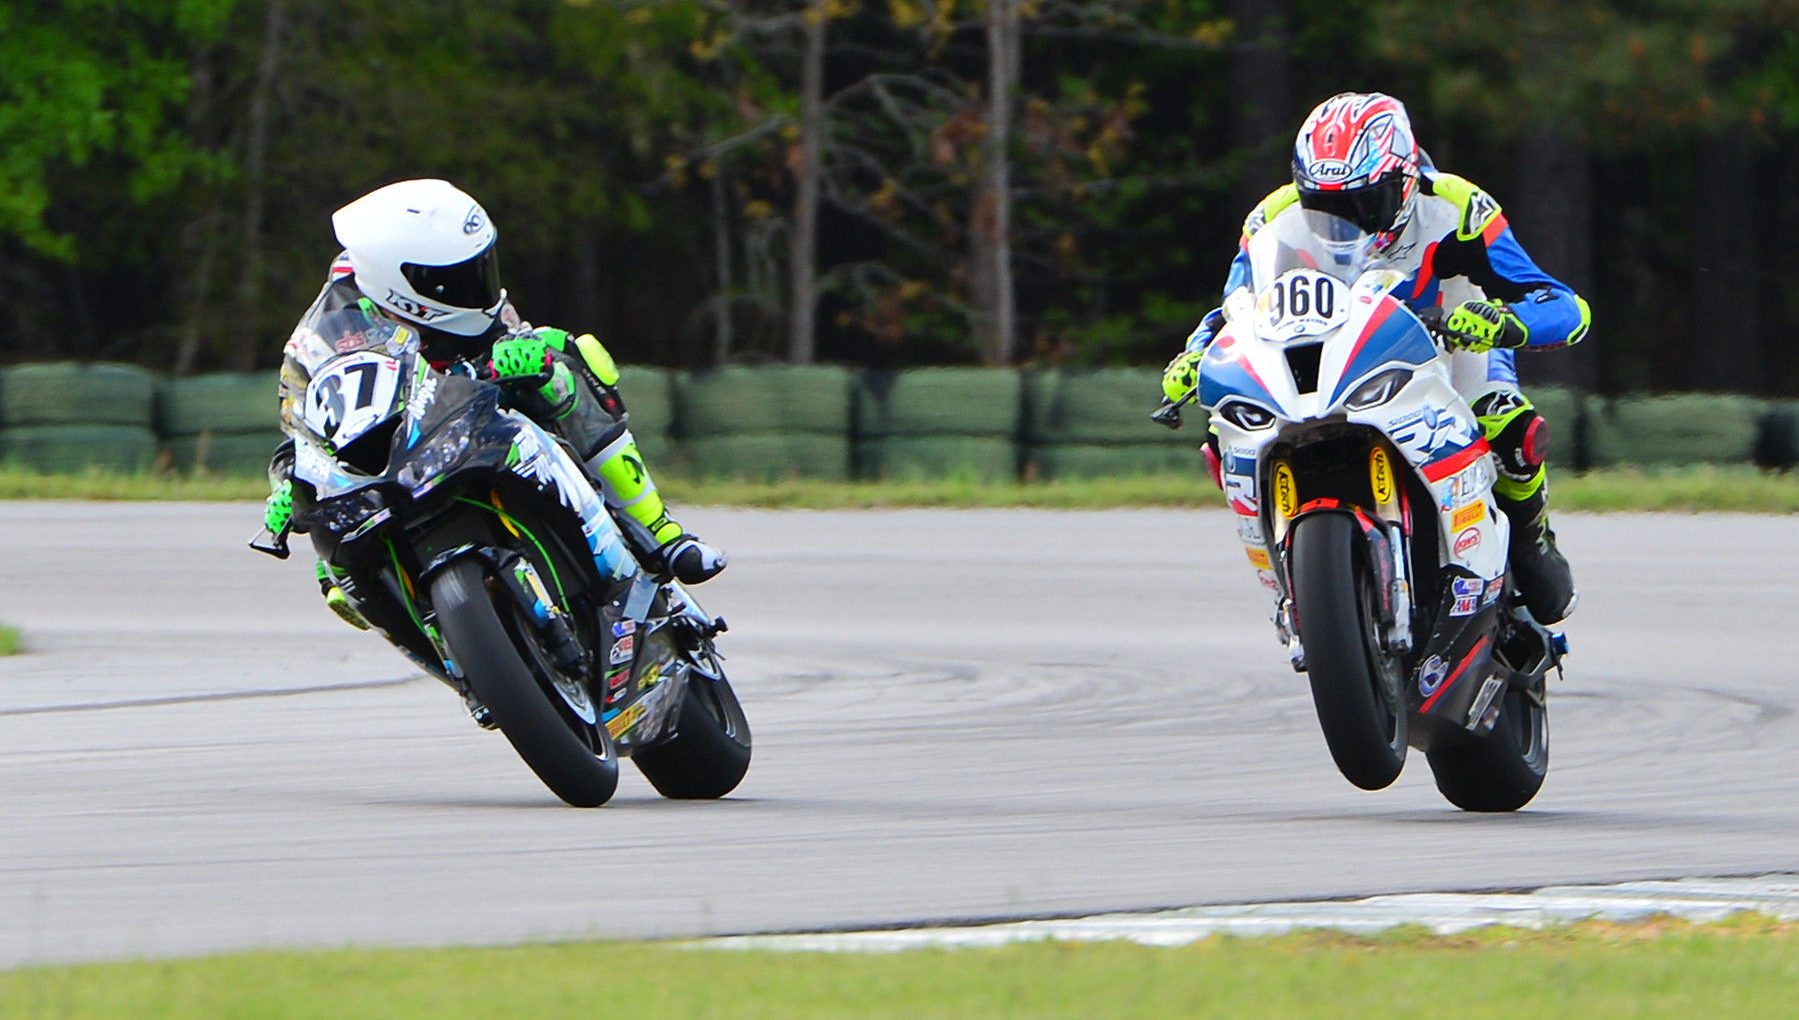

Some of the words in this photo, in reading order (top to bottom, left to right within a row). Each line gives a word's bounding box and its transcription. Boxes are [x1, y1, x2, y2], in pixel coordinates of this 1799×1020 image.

[1311, 162, 1347, 176] Arai
[386, 288, 453, 321] KYT
[1269, 275, 1334, 327] 960
[315, 362, 379, 440] 37
